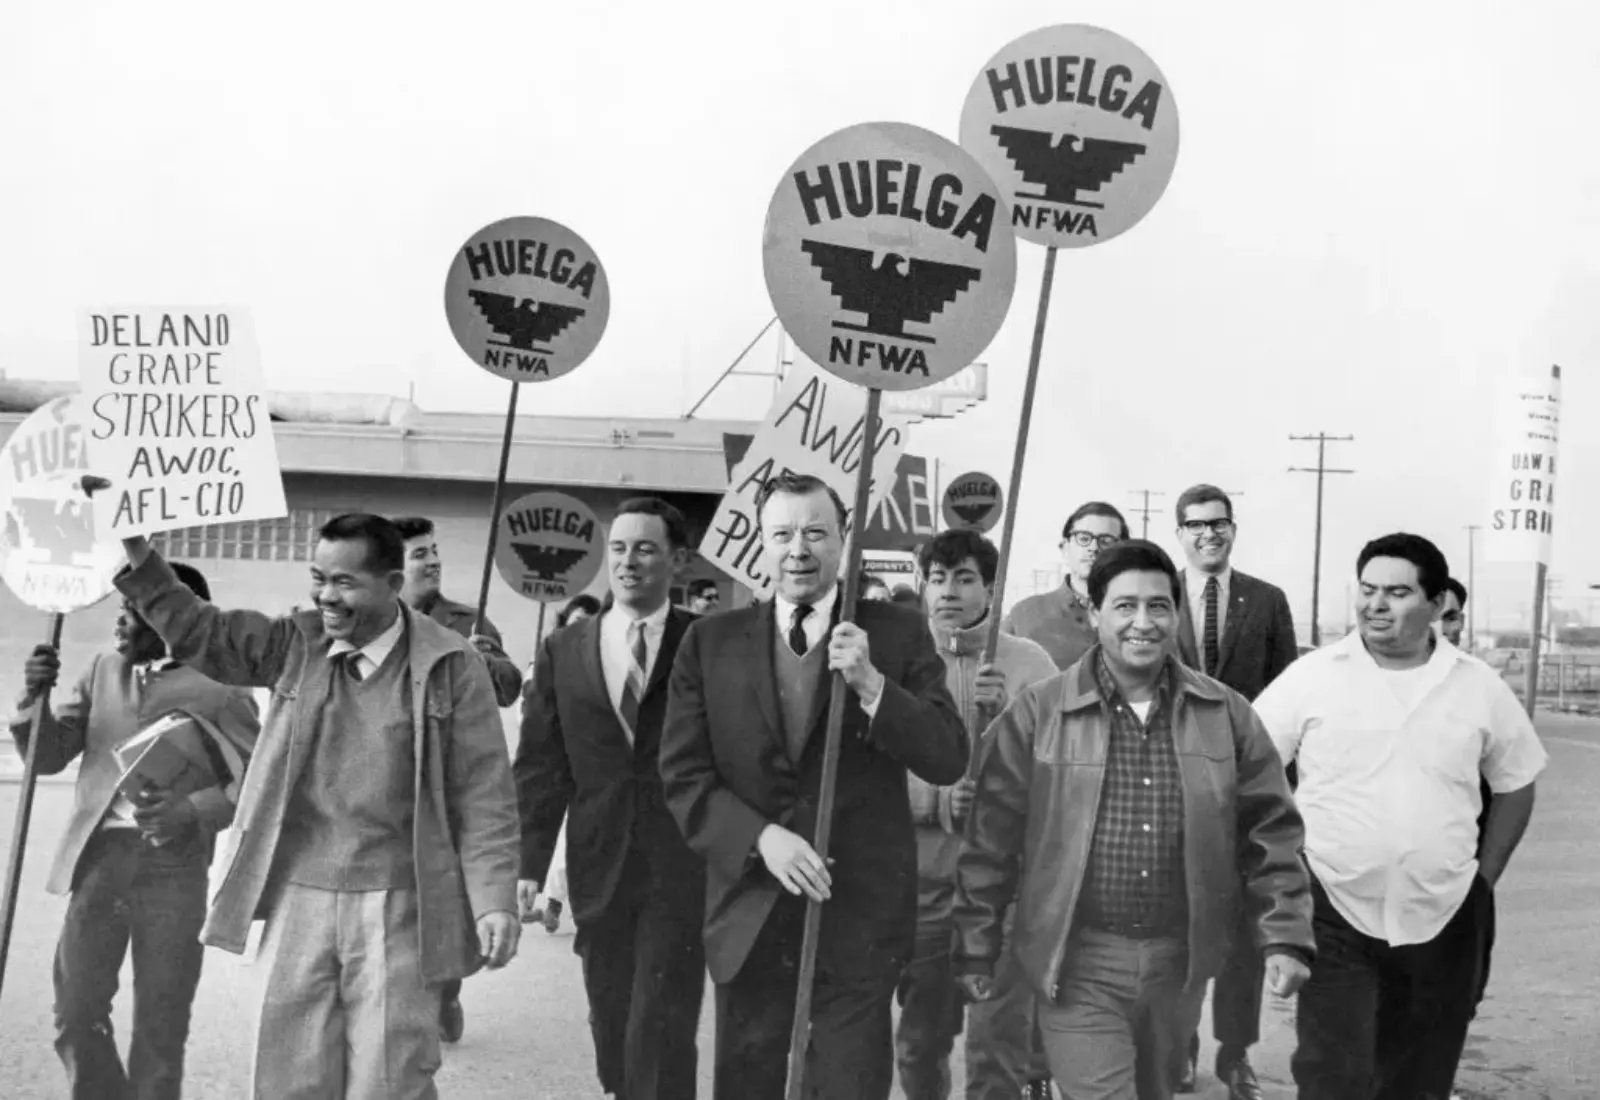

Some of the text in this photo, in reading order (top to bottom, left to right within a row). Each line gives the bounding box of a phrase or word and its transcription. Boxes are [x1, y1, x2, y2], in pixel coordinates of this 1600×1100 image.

[986, 56, 1162, 131] HUELGA
[793, 159, 996, 253] HUELGA
[1012, 204, 1098, 237] NFWA
[463, 239, 597, 300] HUELGA
[91, 313, 230, 347] DELANO
[109, 353, 222, 386] GRAPE
[484, 349, 550, 376] NFWA
[829, 335, 930, 377] NFWA
[91, 393, 259, 440] STRIKERS
[1511, 453, 1543, 471] UAW
[112, 481, 244, 529] AFL-CIO
[507, 507, 595, 544] HUELGA
